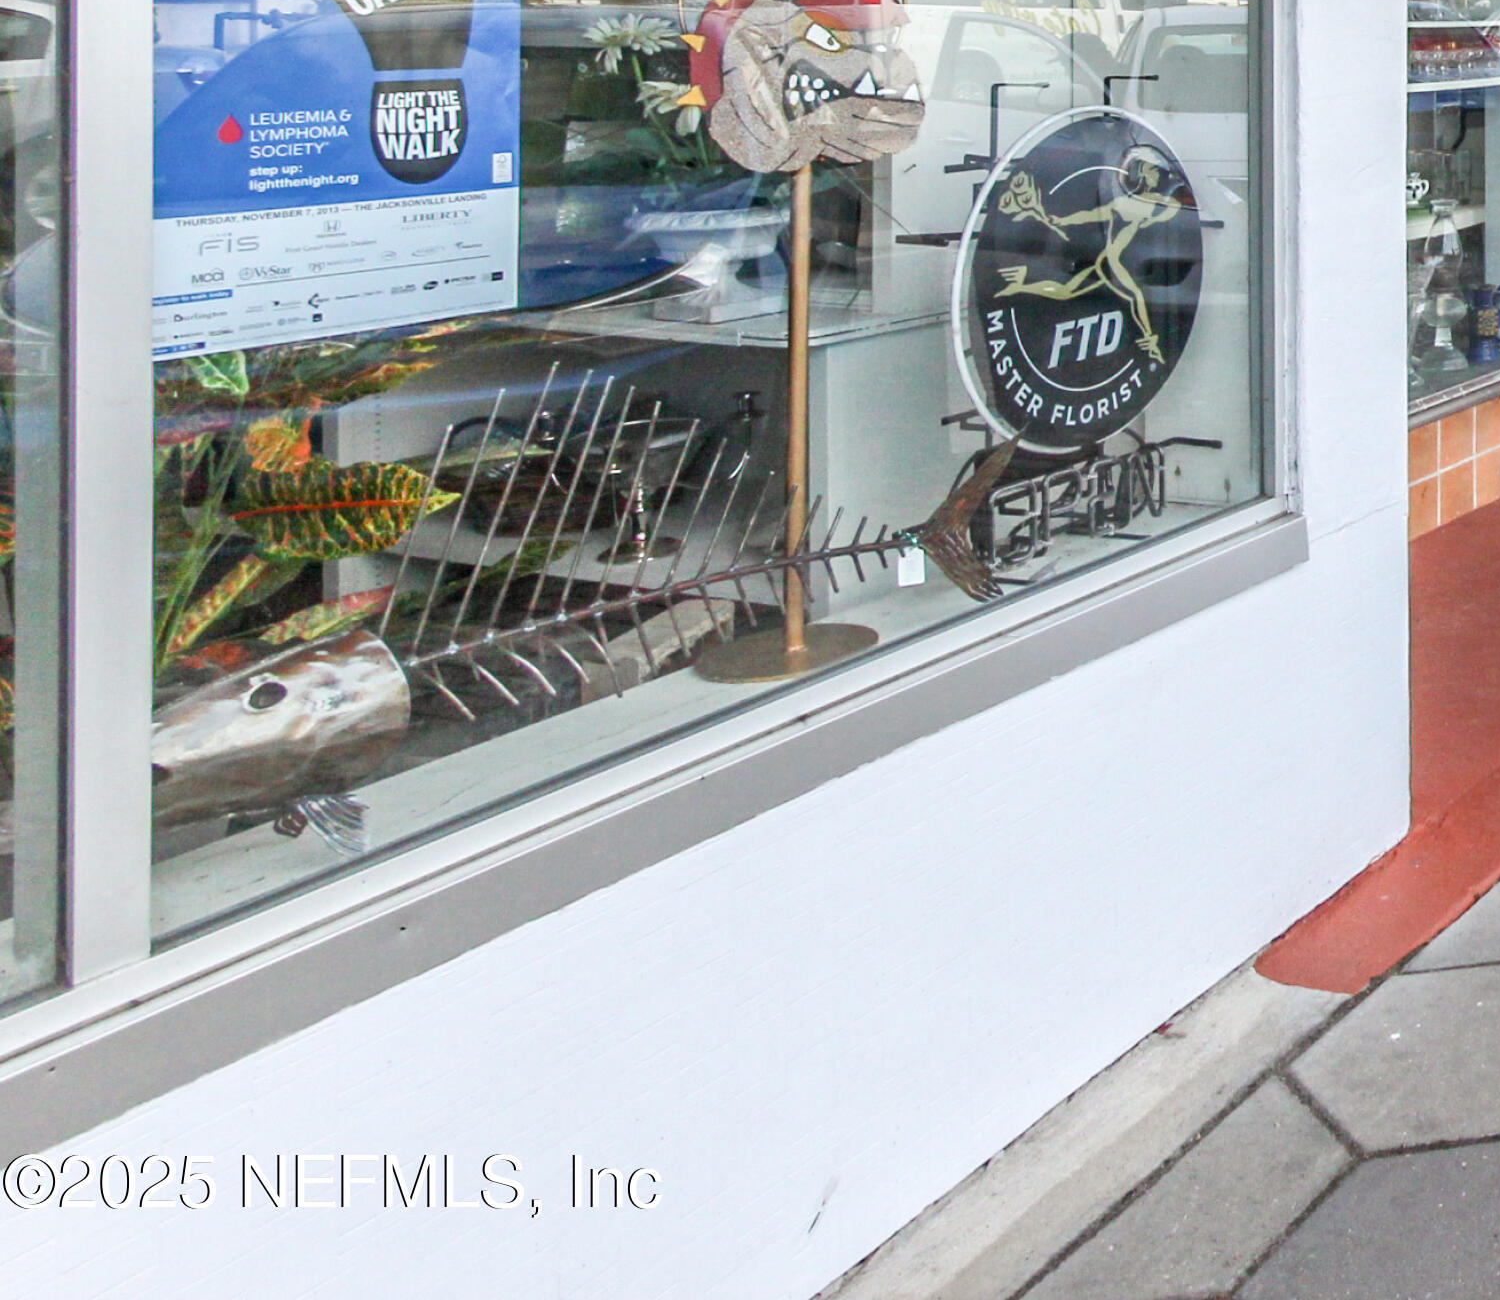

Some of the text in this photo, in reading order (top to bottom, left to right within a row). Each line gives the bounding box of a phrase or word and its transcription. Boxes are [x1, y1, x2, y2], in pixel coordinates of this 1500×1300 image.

[378, 90, 461, 109] LIGHT THE
[250, 109, 352, 126] LEUKEMIA &
[376, 105, 462, 134] NIGHT
[250, 125, 349, 142] LYMPHOMA
[378, 129, 462, 161] WALK
[249, 164, 303, 178] step up:
[249, 174, 360, 193] lightthenight.org
[176, 215, 239, 228] THURSDAY,
[242, 210, 303, 222] NOVEMBER
[316, 206, 340, 216] 2013
[354, 203, 373, 212] THE
[376, 196, 446, 210] JACKSONVILLE
[449, 192, 487, 204] LANDING
[402, 209, 472, 224] LIBERTY
[1047, 309, 1125, 370] FTD
[985, 308, 1143, 427] MASTER FLORIST
